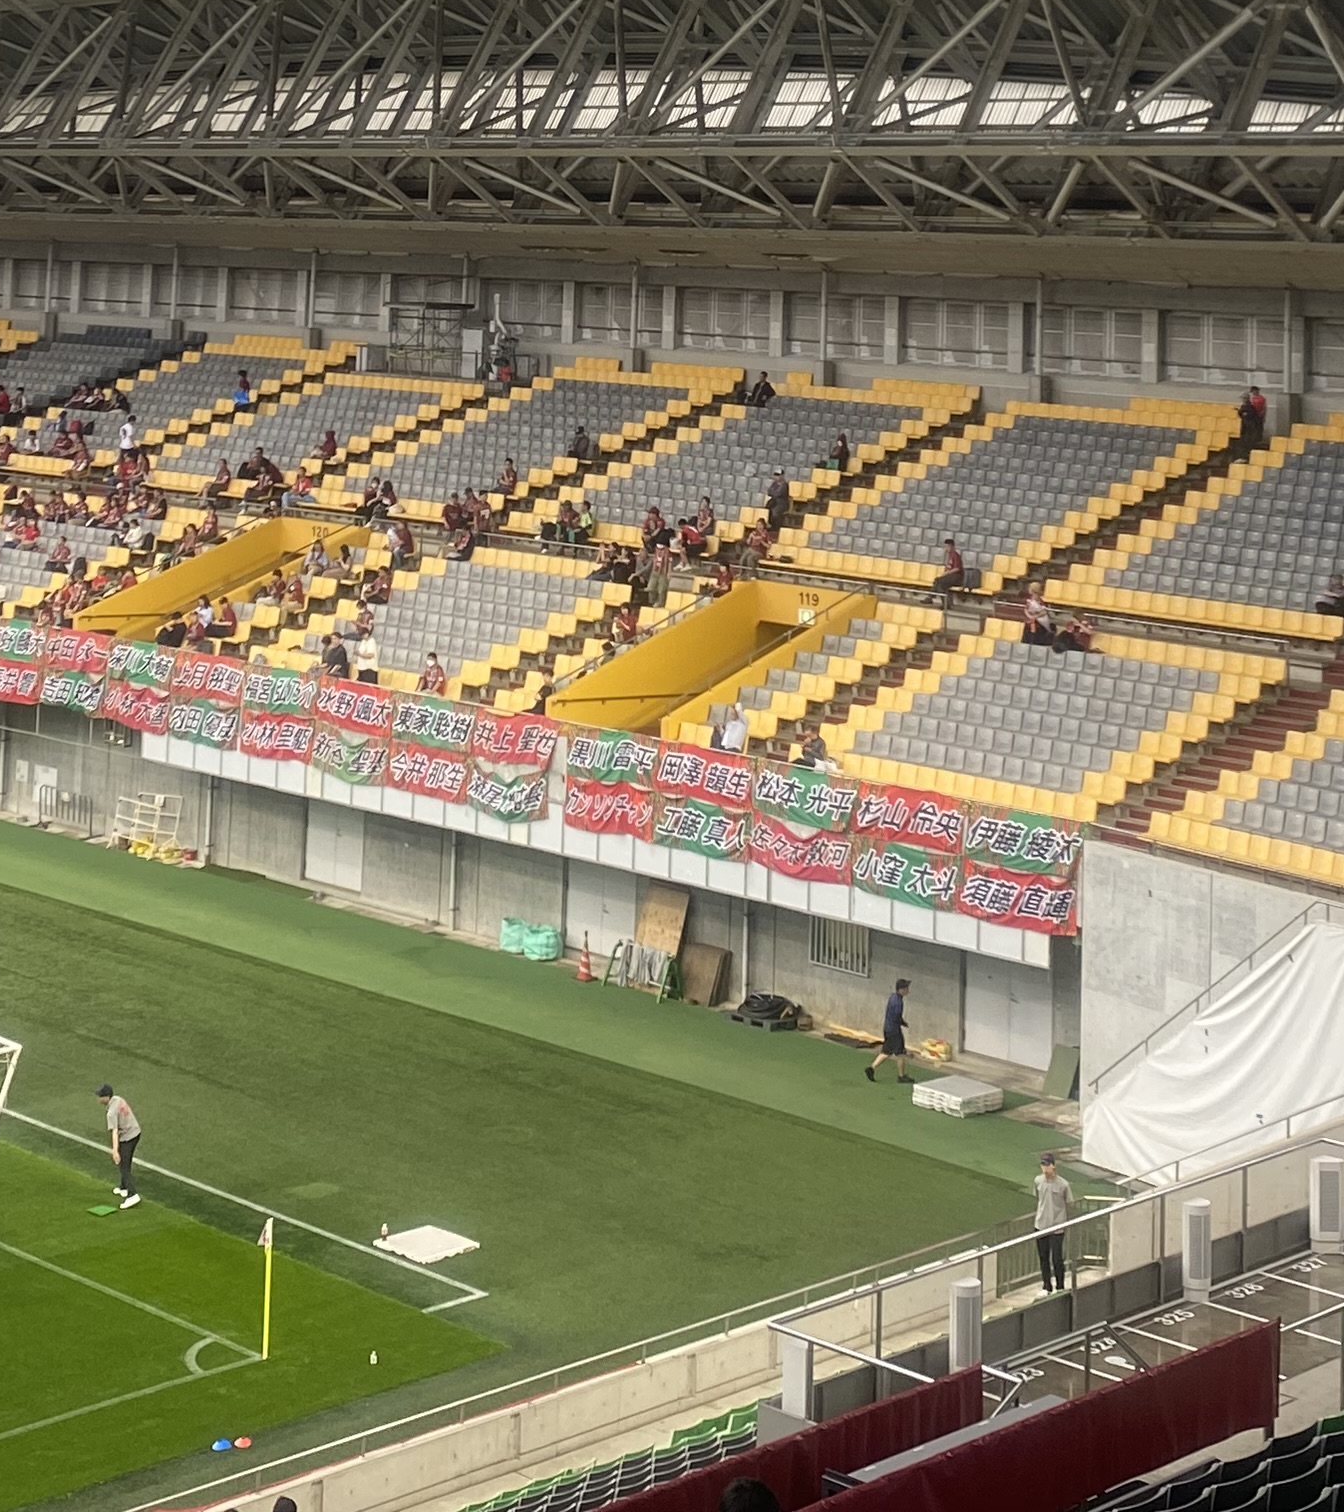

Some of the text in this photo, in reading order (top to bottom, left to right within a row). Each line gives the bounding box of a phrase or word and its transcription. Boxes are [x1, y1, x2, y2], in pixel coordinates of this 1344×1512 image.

[312, 526, 329, 538] 120
[799, 591, 819, 607] 119
[46, 635, 81, 661] 中田
[40, 675, 77, 704] 吉田
[316, 686, 356, 718] 水野
[169, 704, 205, 734] 内田
[241, 720, 279, 749] 小林
[393, 702, 436, 736] 東家
[473, 720, 515, 753] 井上
[567, 738, 613, 770] 黒川
[657, 751, 706, 787] 岡澤
[389, 750, 468, 793] 今井 那生
[755, 769, 857, 821] 松本 光平
[655, 806, 747, 850] 工藤 真人
[856, 794, 910, 832] 杉山
[751, 820, 806, 866] 佐々木
[965, 816, 1029, 857] 伊藤
[853, 848, 958, 901] 小窪 太斗
[961, 874, 1021, 915] 須藤
[1291, 1257, 1328, 1274] 327
[1224, 1281, 1265, 1299] 326
[1153, 1308, 1195, 1326] 325
